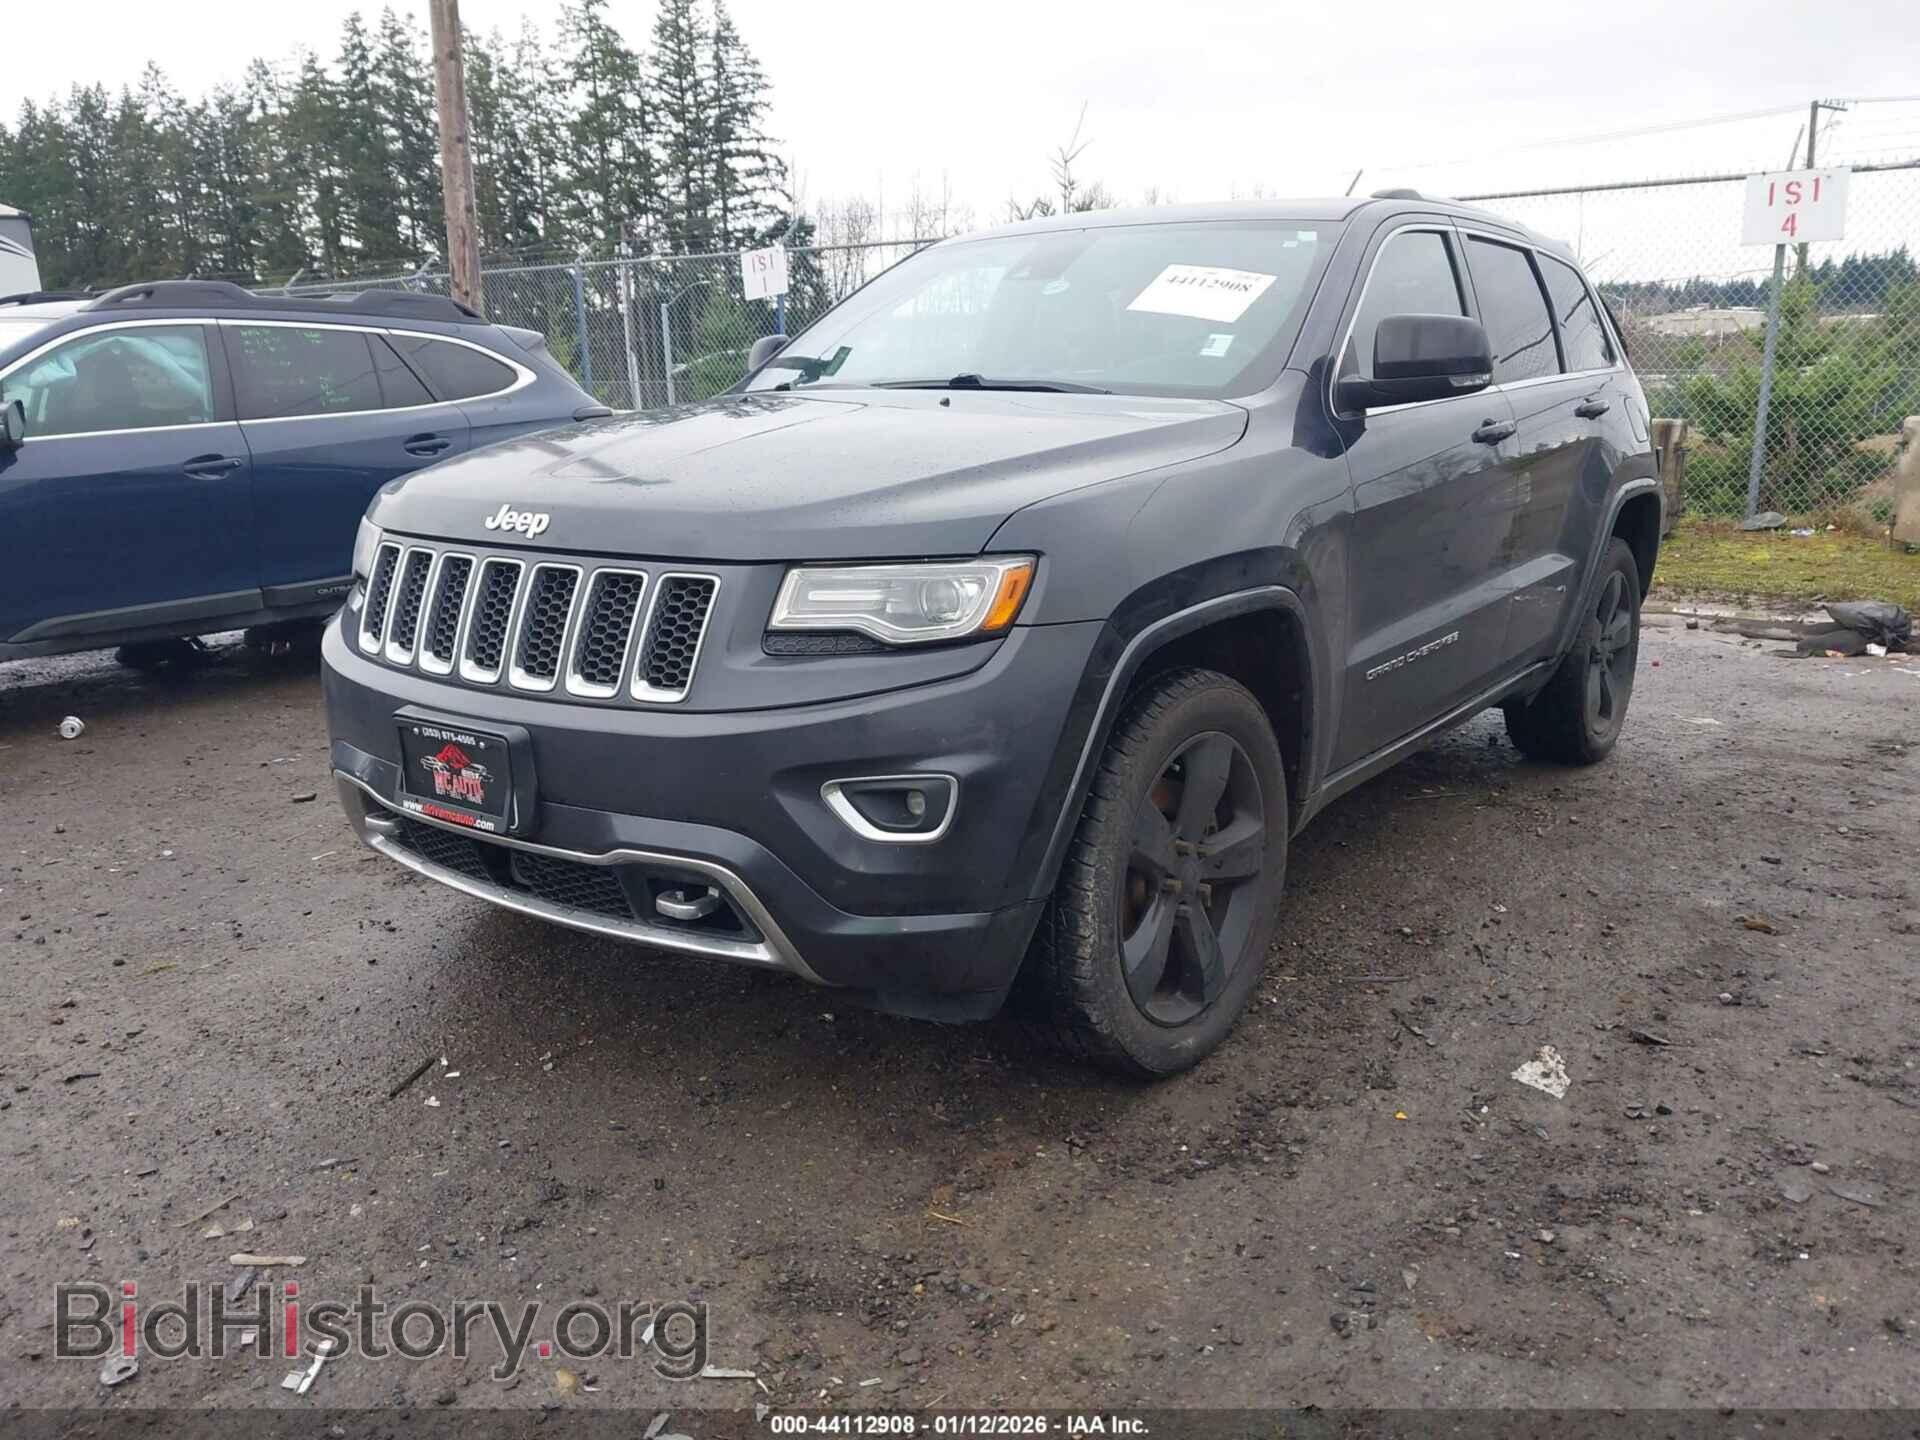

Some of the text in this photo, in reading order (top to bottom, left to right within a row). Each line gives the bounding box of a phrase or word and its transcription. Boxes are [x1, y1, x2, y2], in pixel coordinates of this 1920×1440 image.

[1781, 213, 1797, 237] 4
[484, 503, 550, 539] Jeep
[1366, 631, 1459, 680] GRAND CHEROKEE
